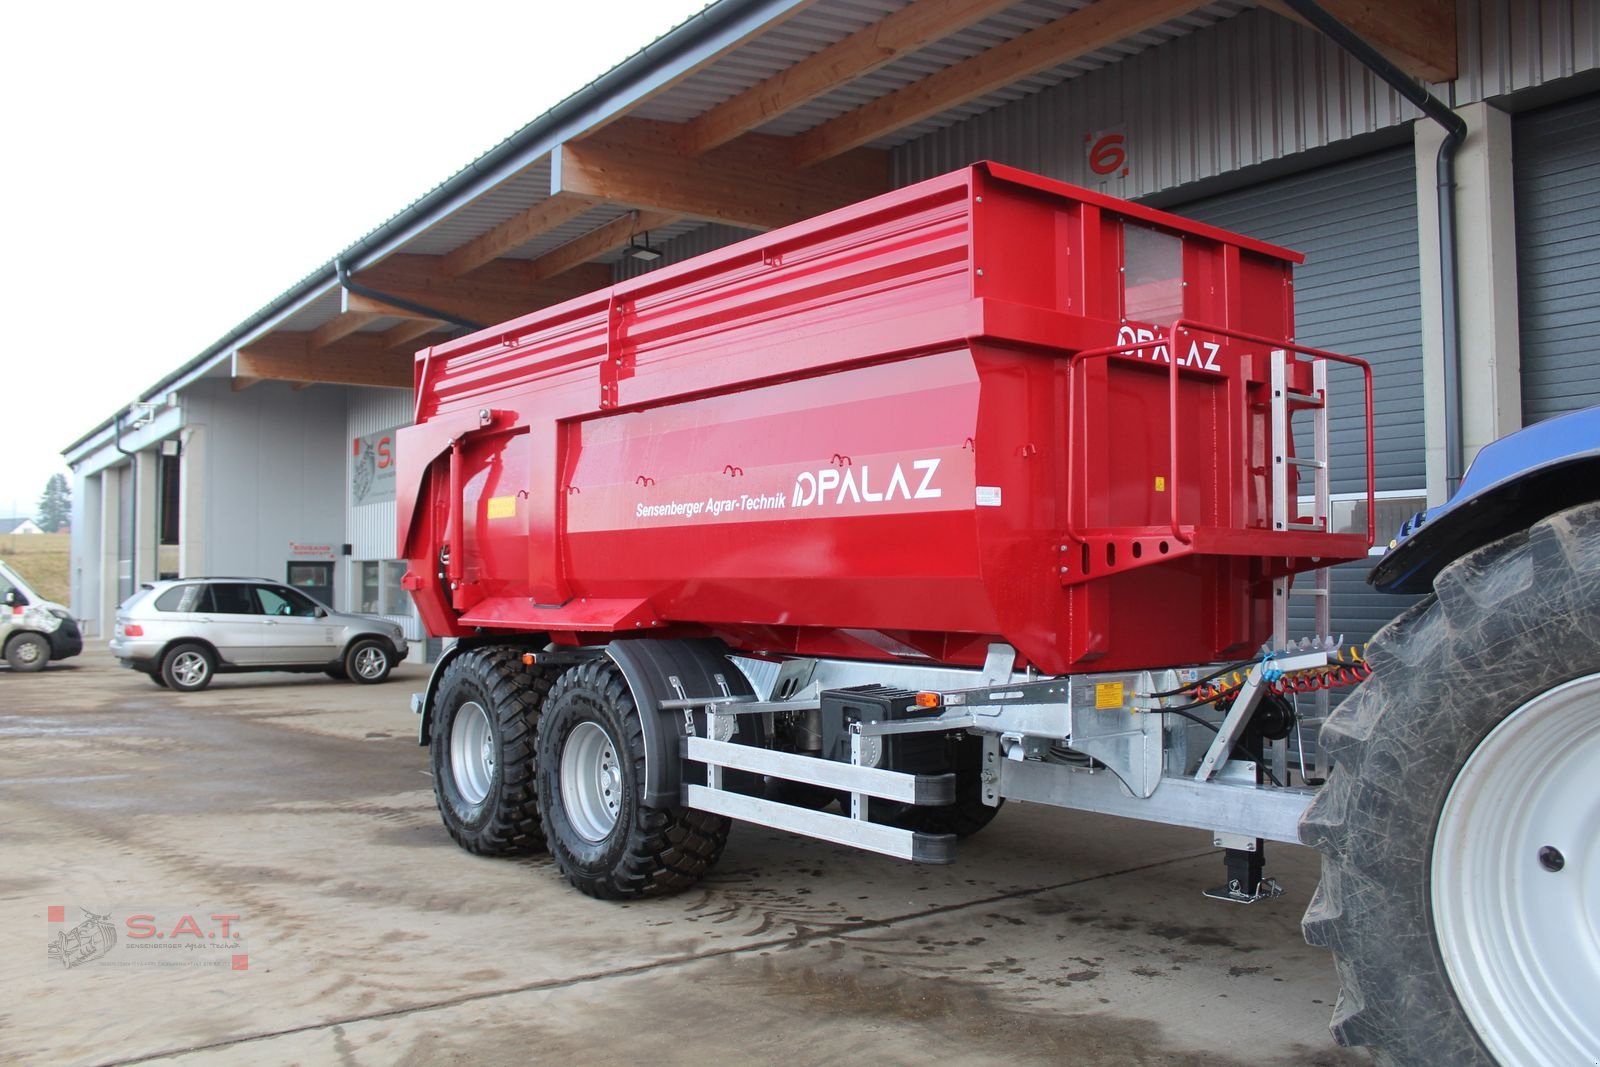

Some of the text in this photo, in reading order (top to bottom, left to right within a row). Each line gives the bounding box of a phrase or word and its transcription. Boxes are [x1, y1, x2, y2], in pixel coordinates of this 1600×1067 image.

[1089, 134, 1125, 175] 6
[636, 492, 786, 518] Sensenberger Agrar-Technik
